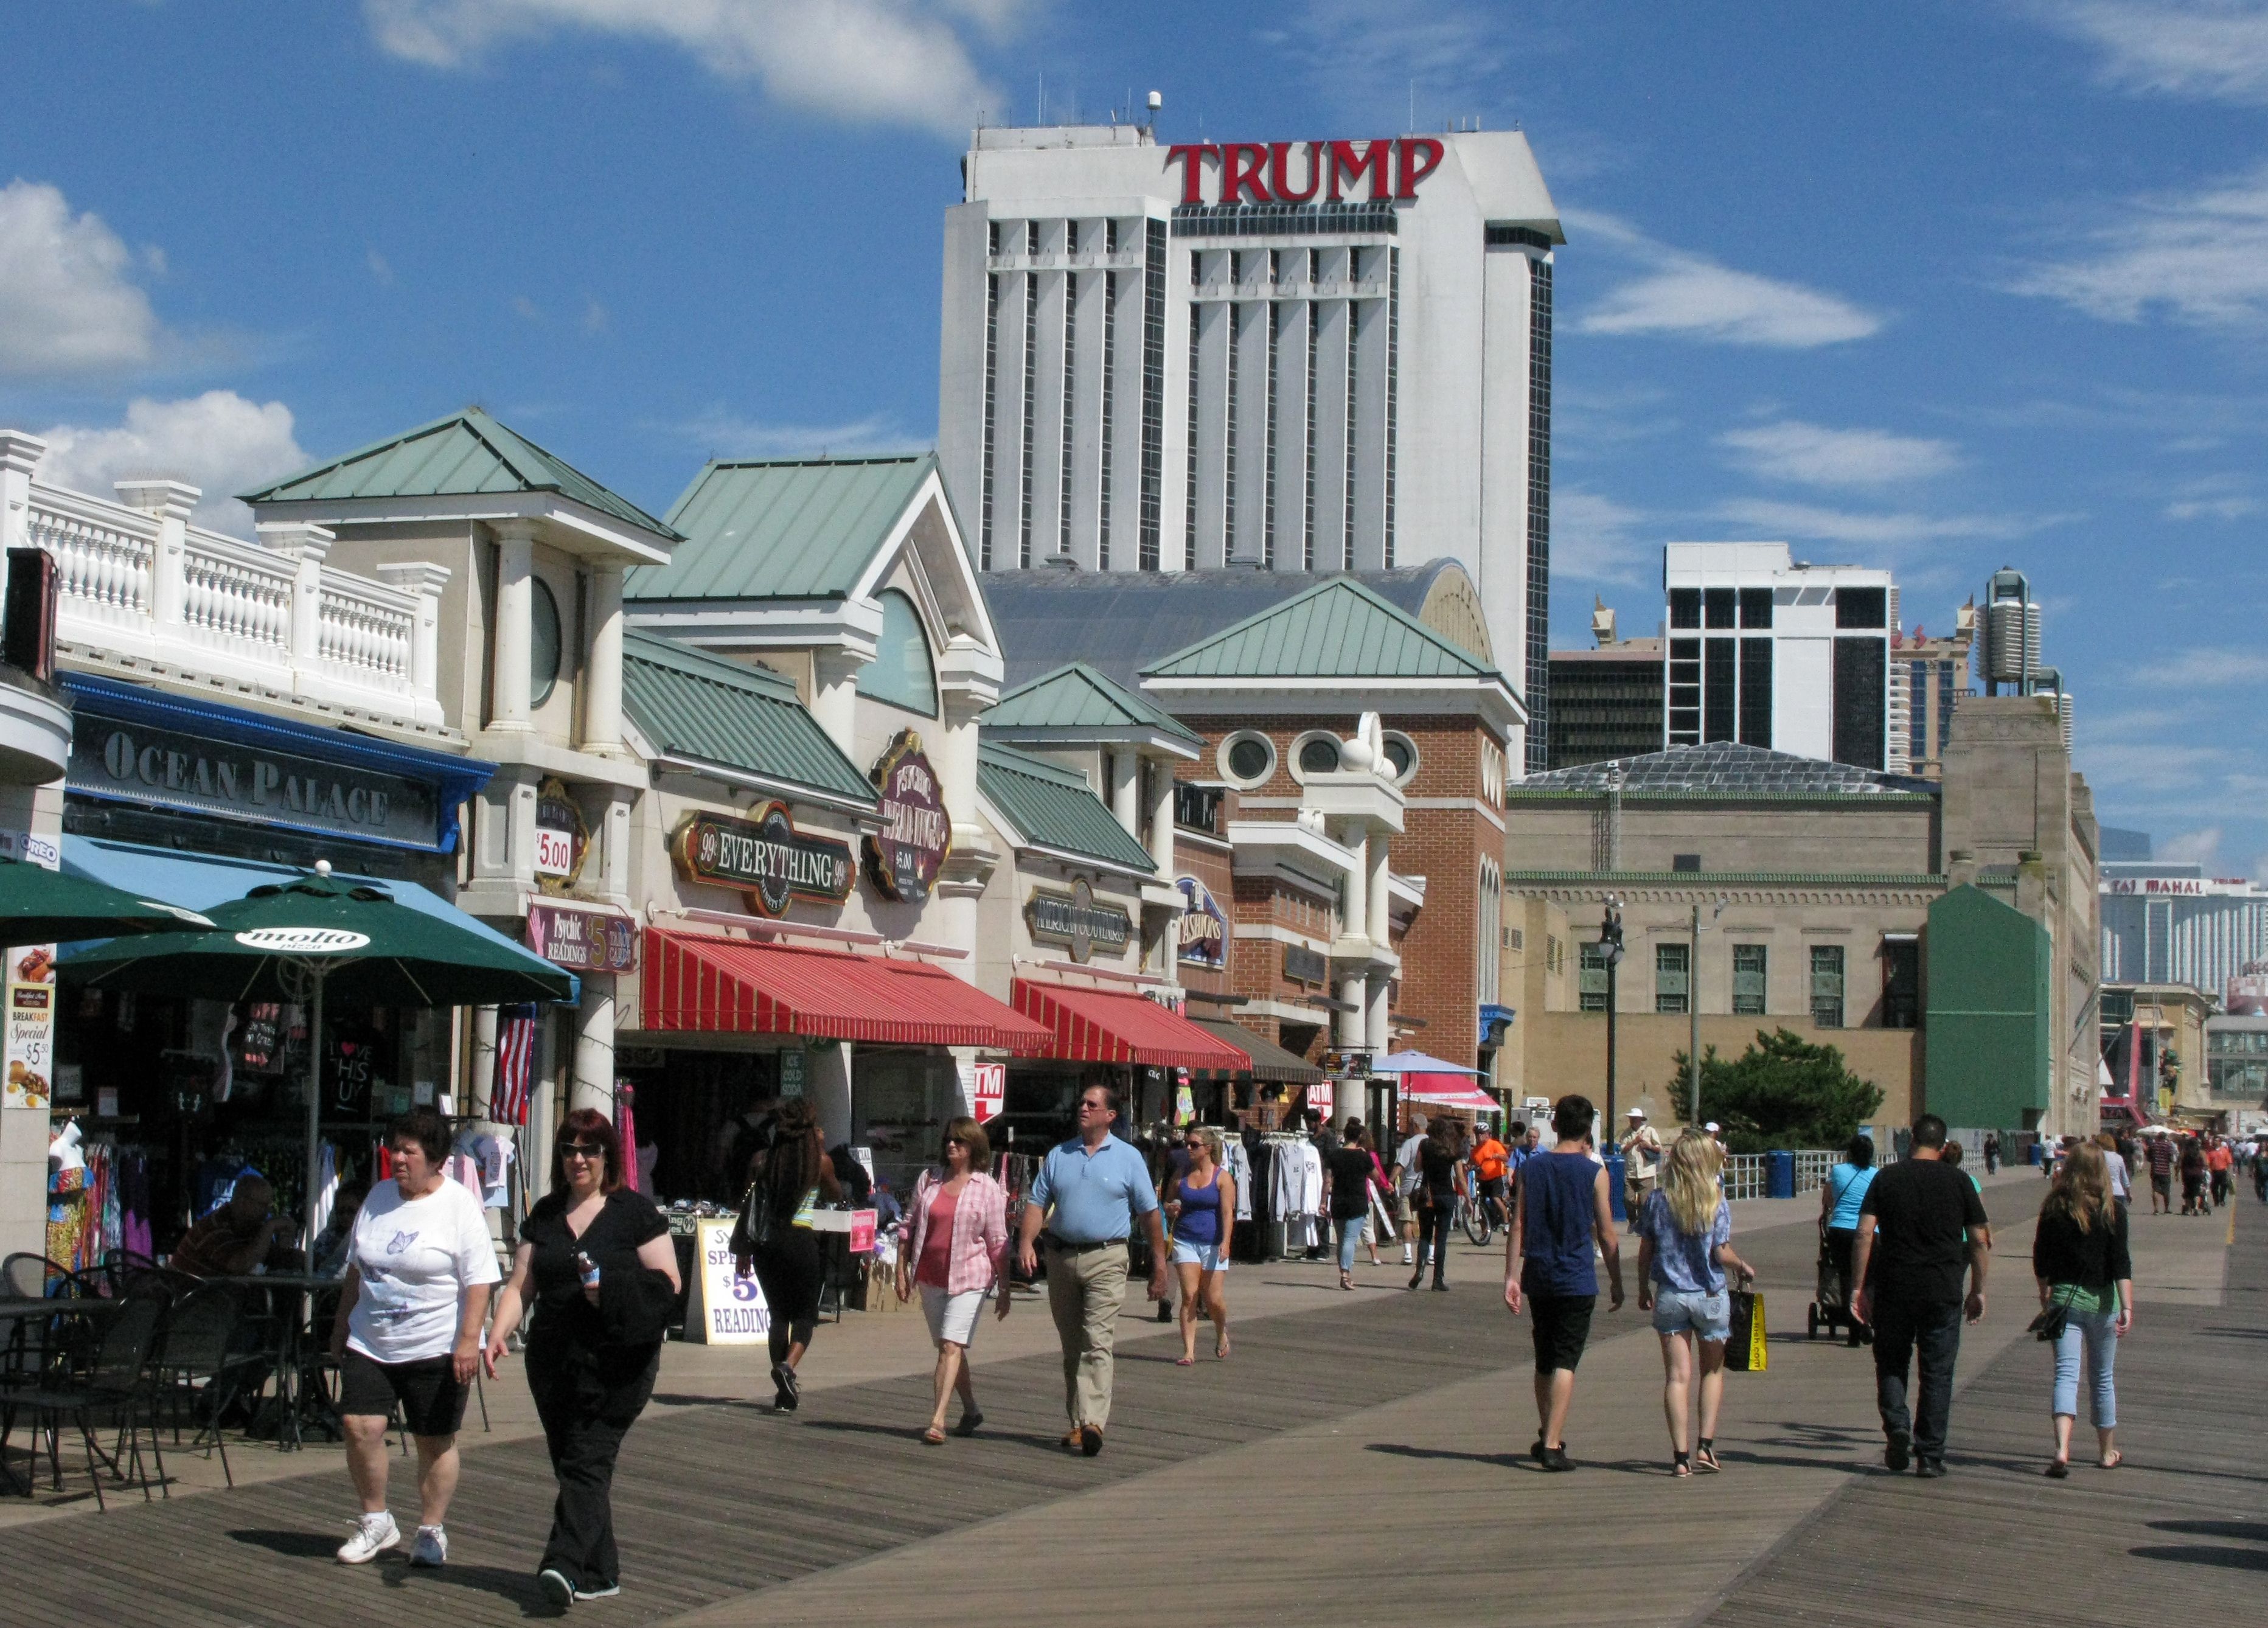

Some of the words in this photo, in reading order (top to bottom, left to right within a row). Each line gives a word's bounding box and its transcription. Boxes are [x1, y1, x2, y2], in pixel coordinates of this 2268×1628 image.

[1166, 139, 1444, 203] TRUMP
[104, 731, 238, 800] OCEAN
[251, 760, 388, 826] PALACE
[883, 799, 941, 851] READINGS
[20, 834, 58, 862] OREO
[537, 832, 568, 869] $5.00
[718, 832, 832, 888] EVERYTHING
[2113, 879, 2137, 895] TAJ
[2146, 879, 2203, 894] MAHAL
[250, 931, 358, 944] molto
[554, 913, 582, 945] Psychic
[548, 942, 587, 963] READINGS
[13, 1011, 49, 1023] BREAKFAST
[10, 1023, 49, 1044] Special
[1309, 1084, 1331, 1102] ATM
[723, 1271, 758, 1301] $5
